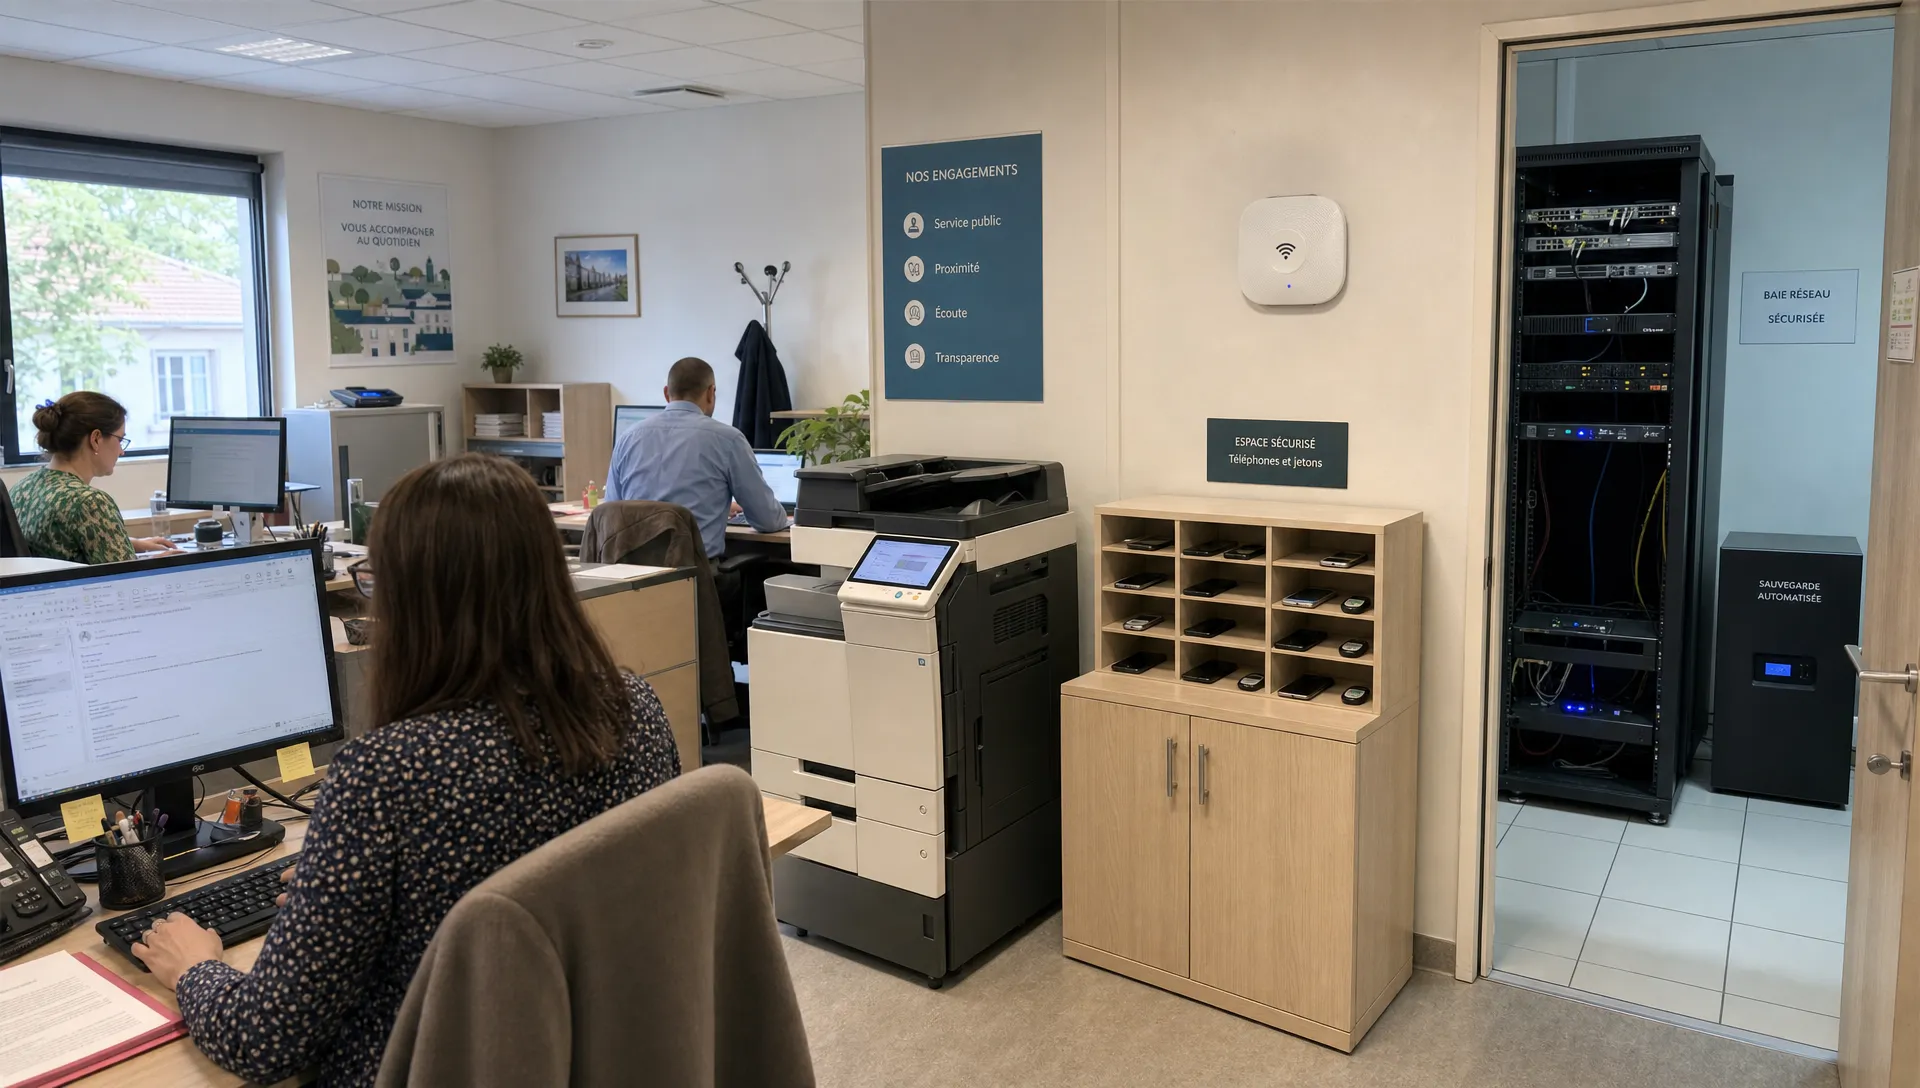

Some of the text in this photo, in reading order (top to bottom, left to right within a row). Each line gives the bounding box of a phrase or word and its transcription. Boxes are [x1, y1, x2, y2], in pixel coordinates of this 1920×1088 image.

[905, 164, 1018, 183] NOS ENGAGEMENTS
[352, 200, 422, 213] NOTRE MISSION
[934, 215, 1001, 230] Service public
[341, 223, 434, 236] VOUS ACCOMPAGNER
[357, 236, 420, 247] AU QUOTIDIEN
[934, 262, 980, 274] Proximité
[1764, 288, 1831, 299] BAIE RÉSEAU
[935, 305, 968, 319] Écoute
[1768, 312, 1825, 323] SÉCURISÉE
[935, 352, 1000, 365] Transparence
[1235, 436, 1316, 449] ESPACE SÉCURISÉ
[1229, 454, 1323, 469] Téléphones et jetons
[1759, 580, 1820, 590] SAUVEGARDE
[1758, 592, 1822, 603] AUTOMATISÉE
